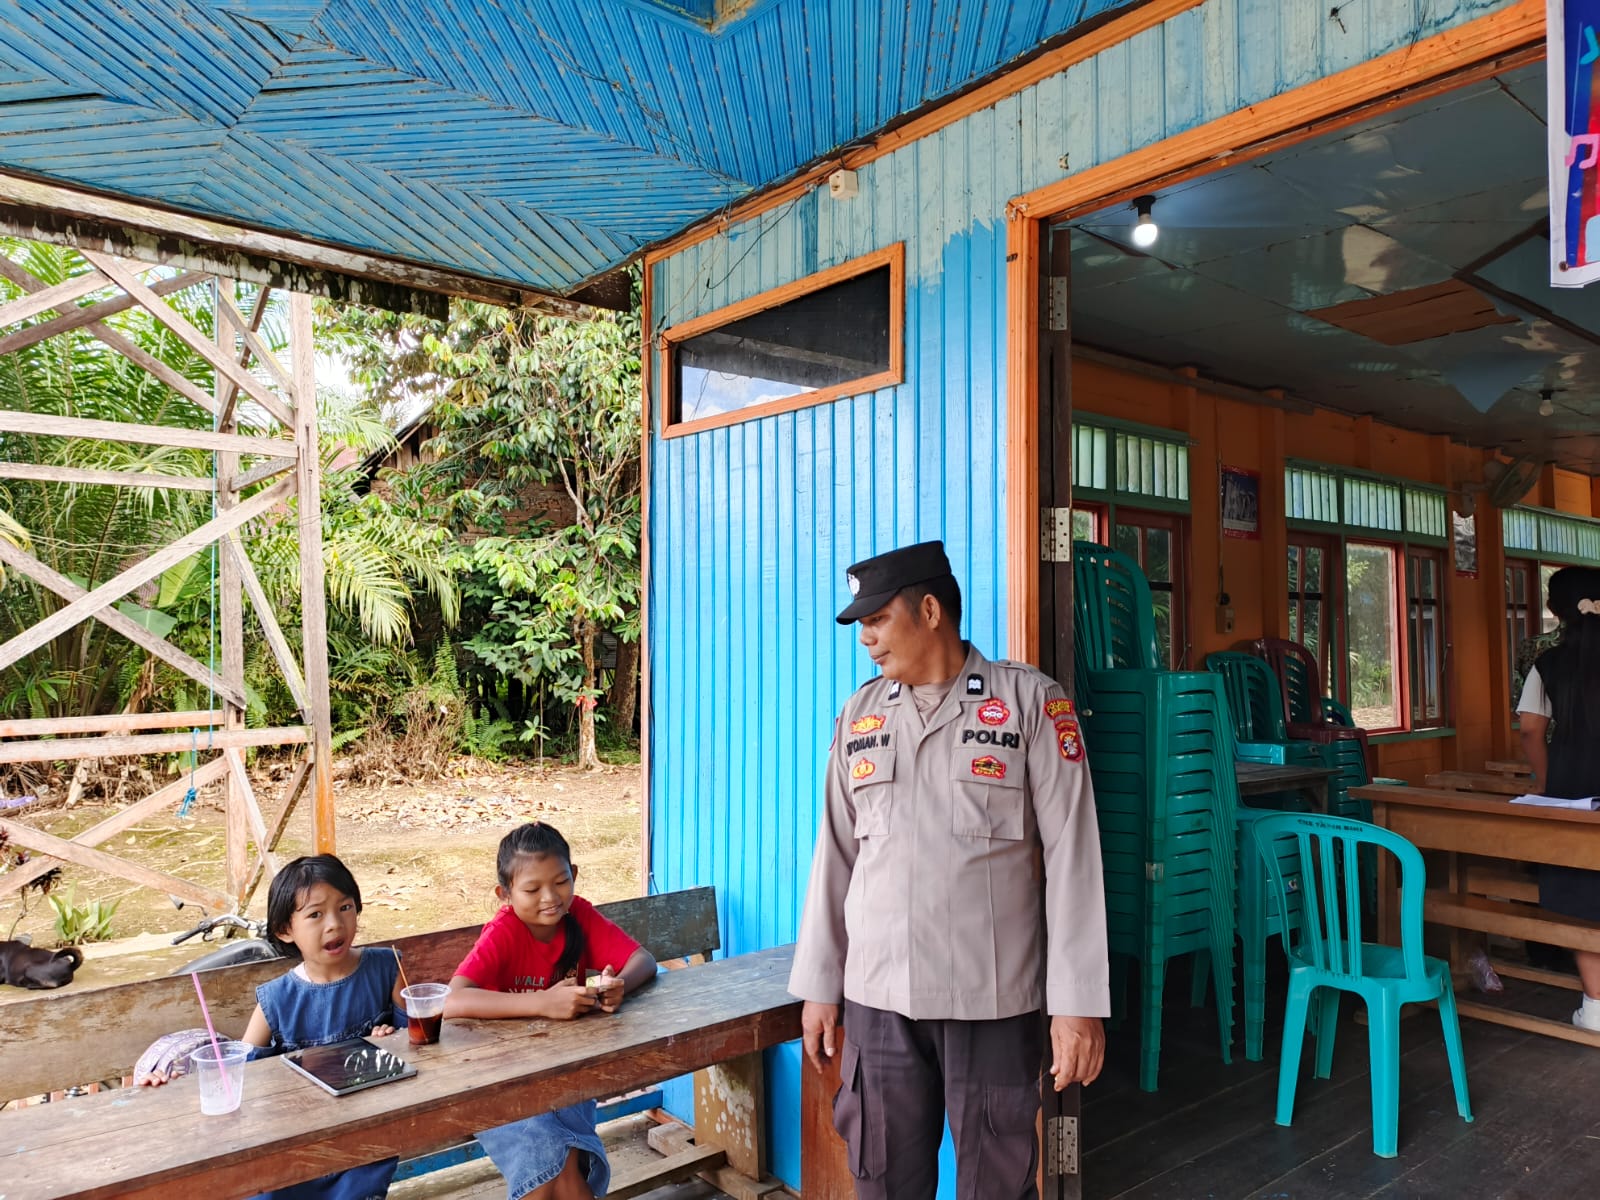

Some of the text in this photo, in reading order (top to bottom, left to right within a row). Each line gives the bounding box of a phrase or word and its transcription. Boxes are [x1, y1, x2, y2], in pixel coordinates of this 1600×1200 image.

[881, 733, 890, 747] W
[962, 729, 1020, 749] POLRI
[515, 975, 545, 987] WALK
